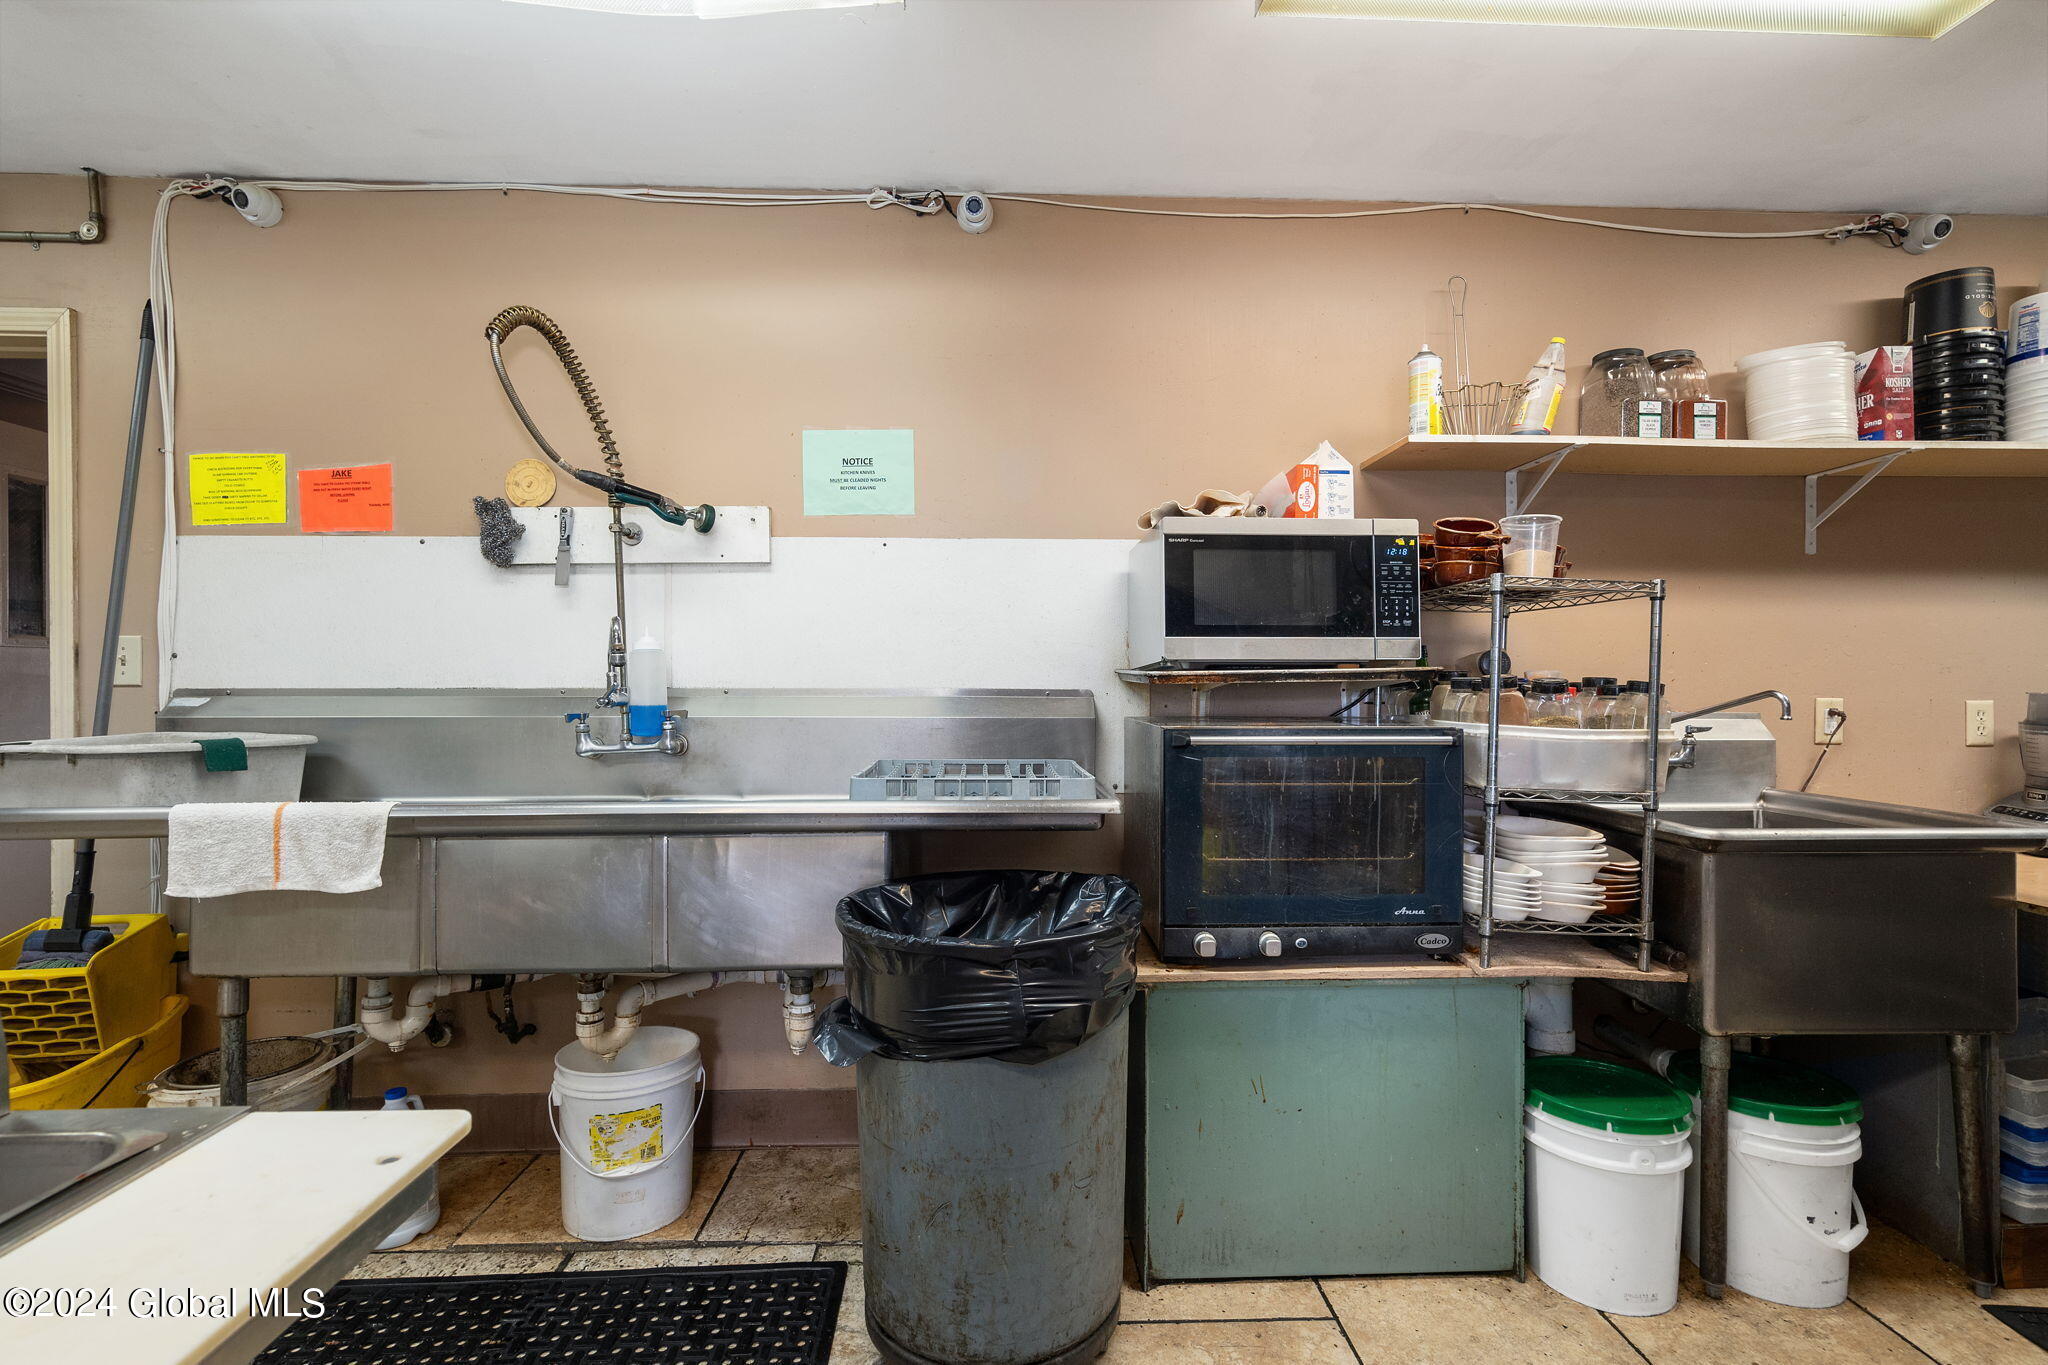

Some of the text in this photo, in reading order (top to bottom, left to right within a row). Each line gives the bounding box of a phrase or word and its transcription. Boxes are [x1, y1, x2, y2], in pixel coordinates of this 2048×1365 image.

[1885, 377, 1911, 388] KOSHER
[842, 457, 873, 466] NOTICE
[331, 469, 352, 478] JAKE
[1386, 547, 1408, 556] 12:18
[1394, 906, 1426, 915] Anna
[1420, 937, 1447, 945] Cadco
